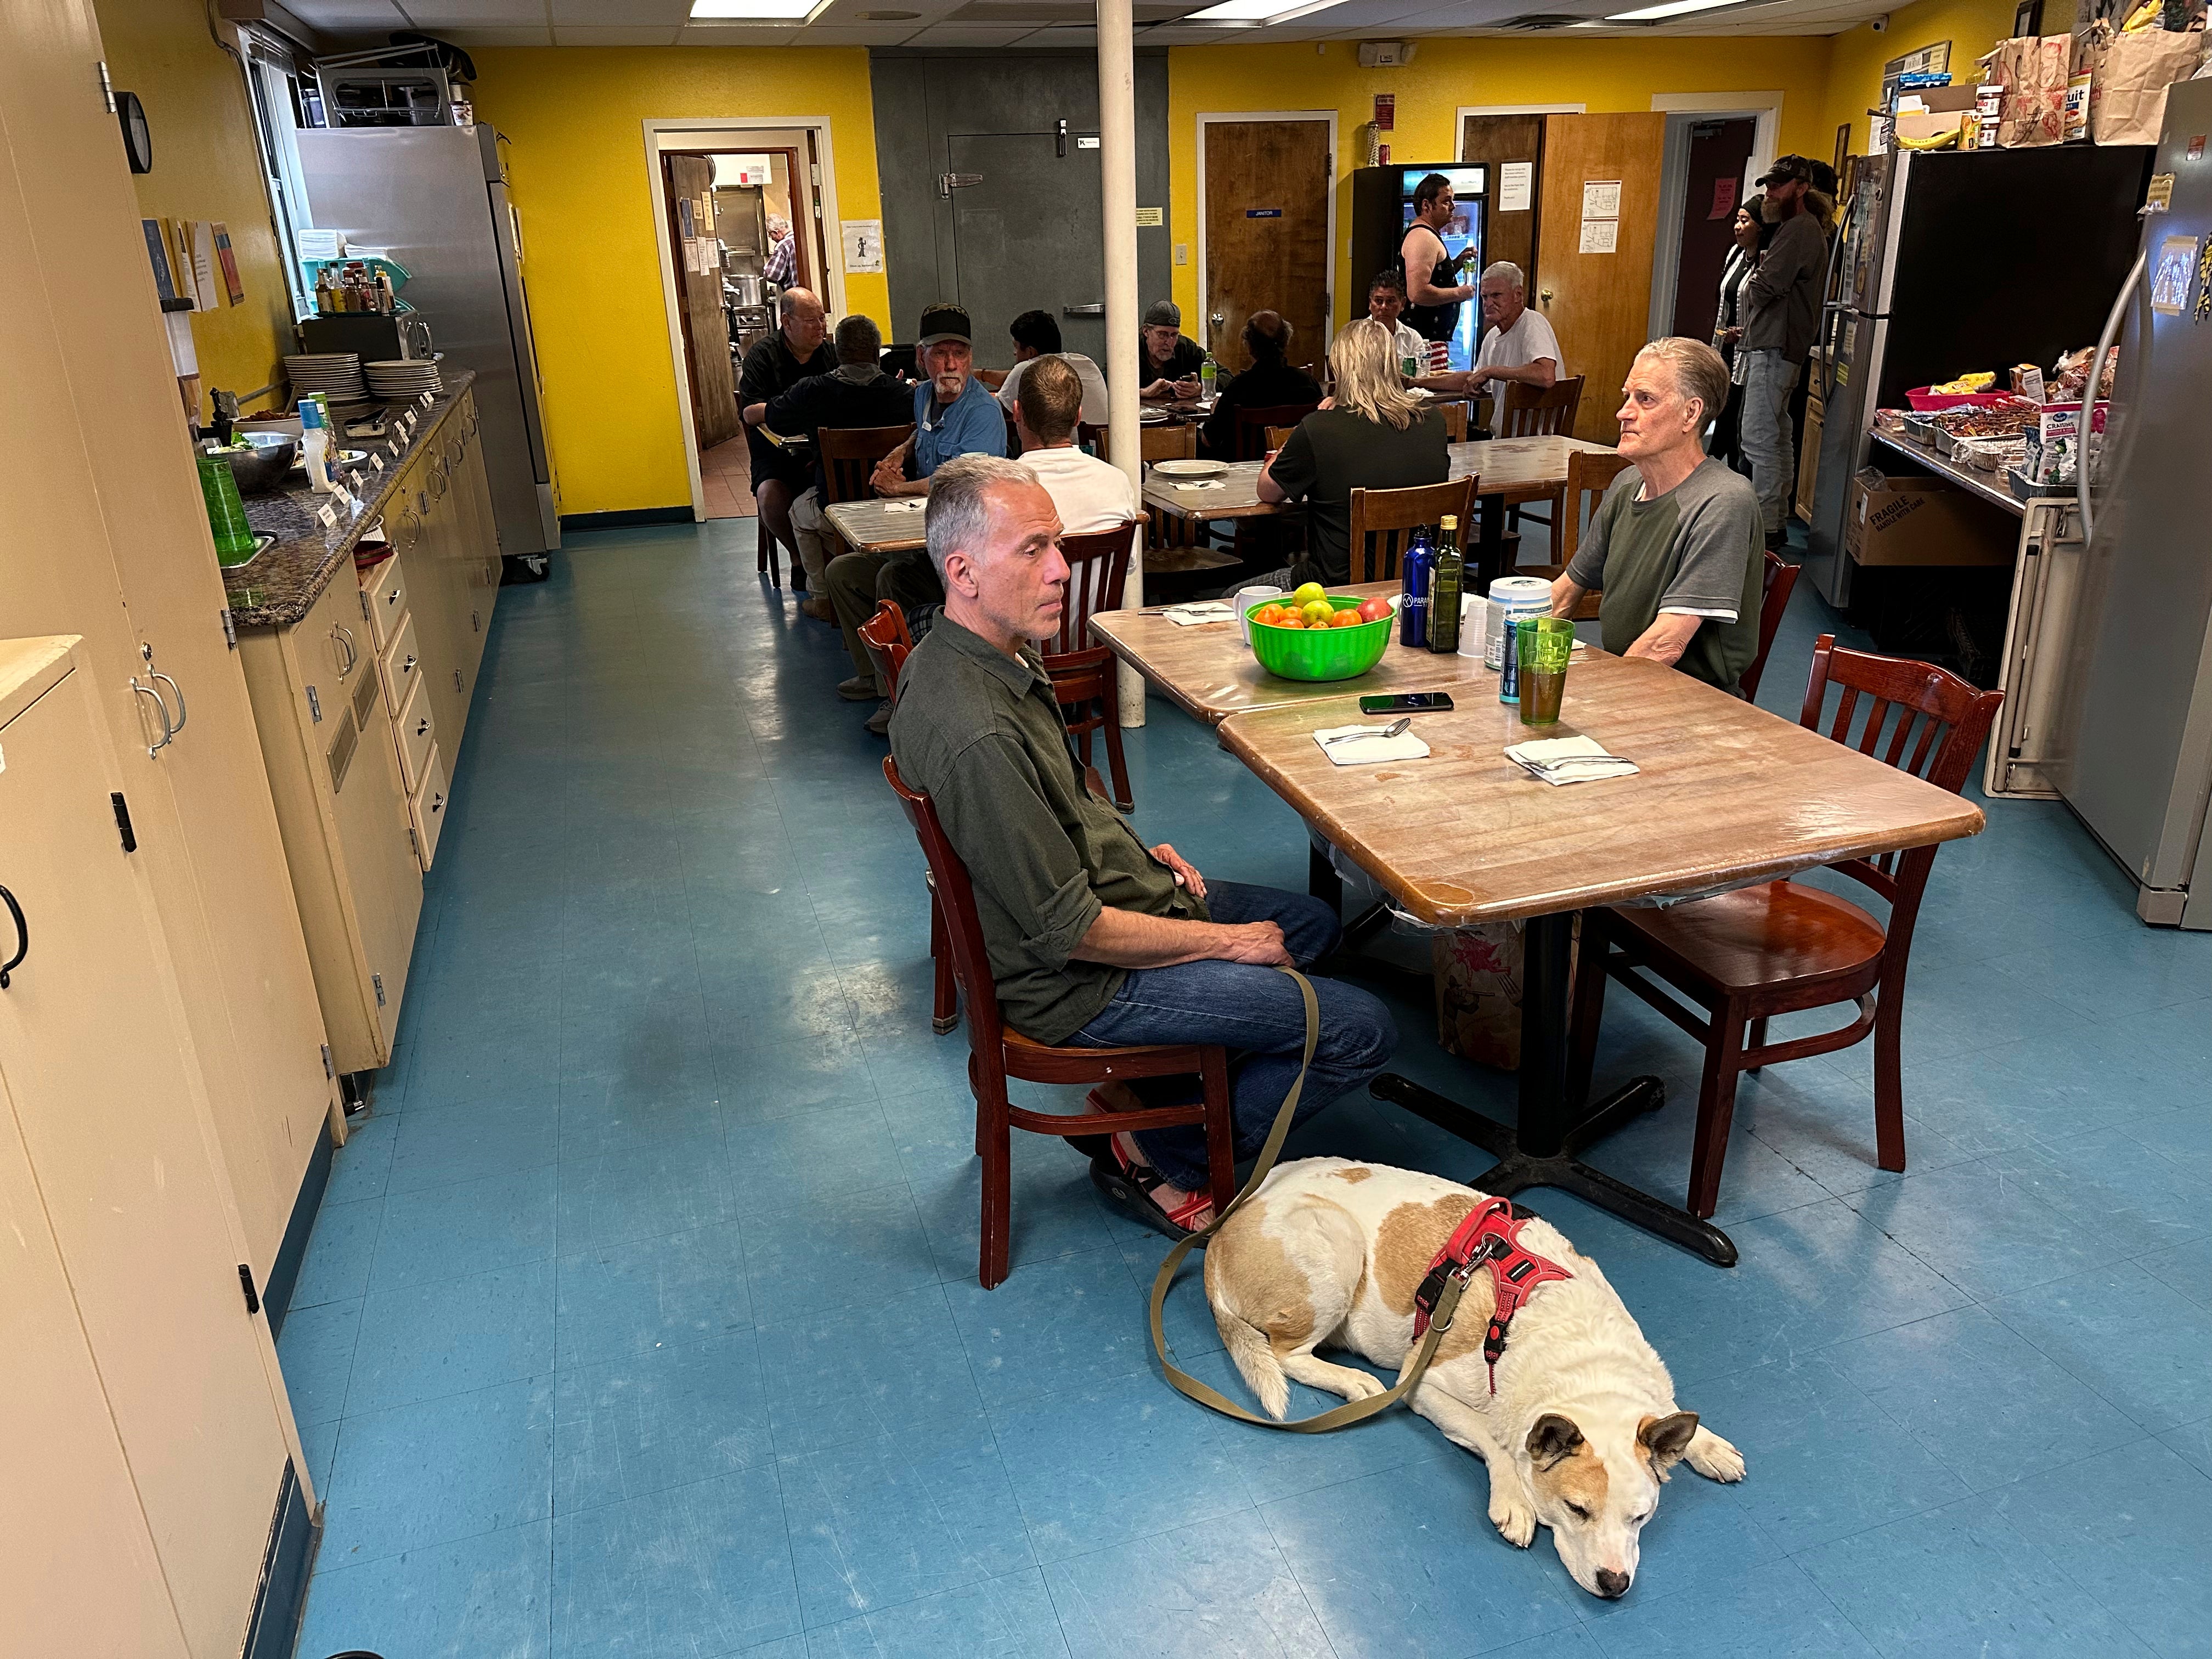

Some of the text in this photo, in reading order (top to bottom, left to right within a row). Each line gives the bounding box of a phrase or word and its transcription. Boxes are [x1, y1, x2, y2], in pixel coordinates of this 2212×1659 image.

[2067, 89, 2084, 102] uit
[1869, 495, 1910, 525] FRAGILE
[1875, 497, 1925, 532] HANDLE WITH CARE
